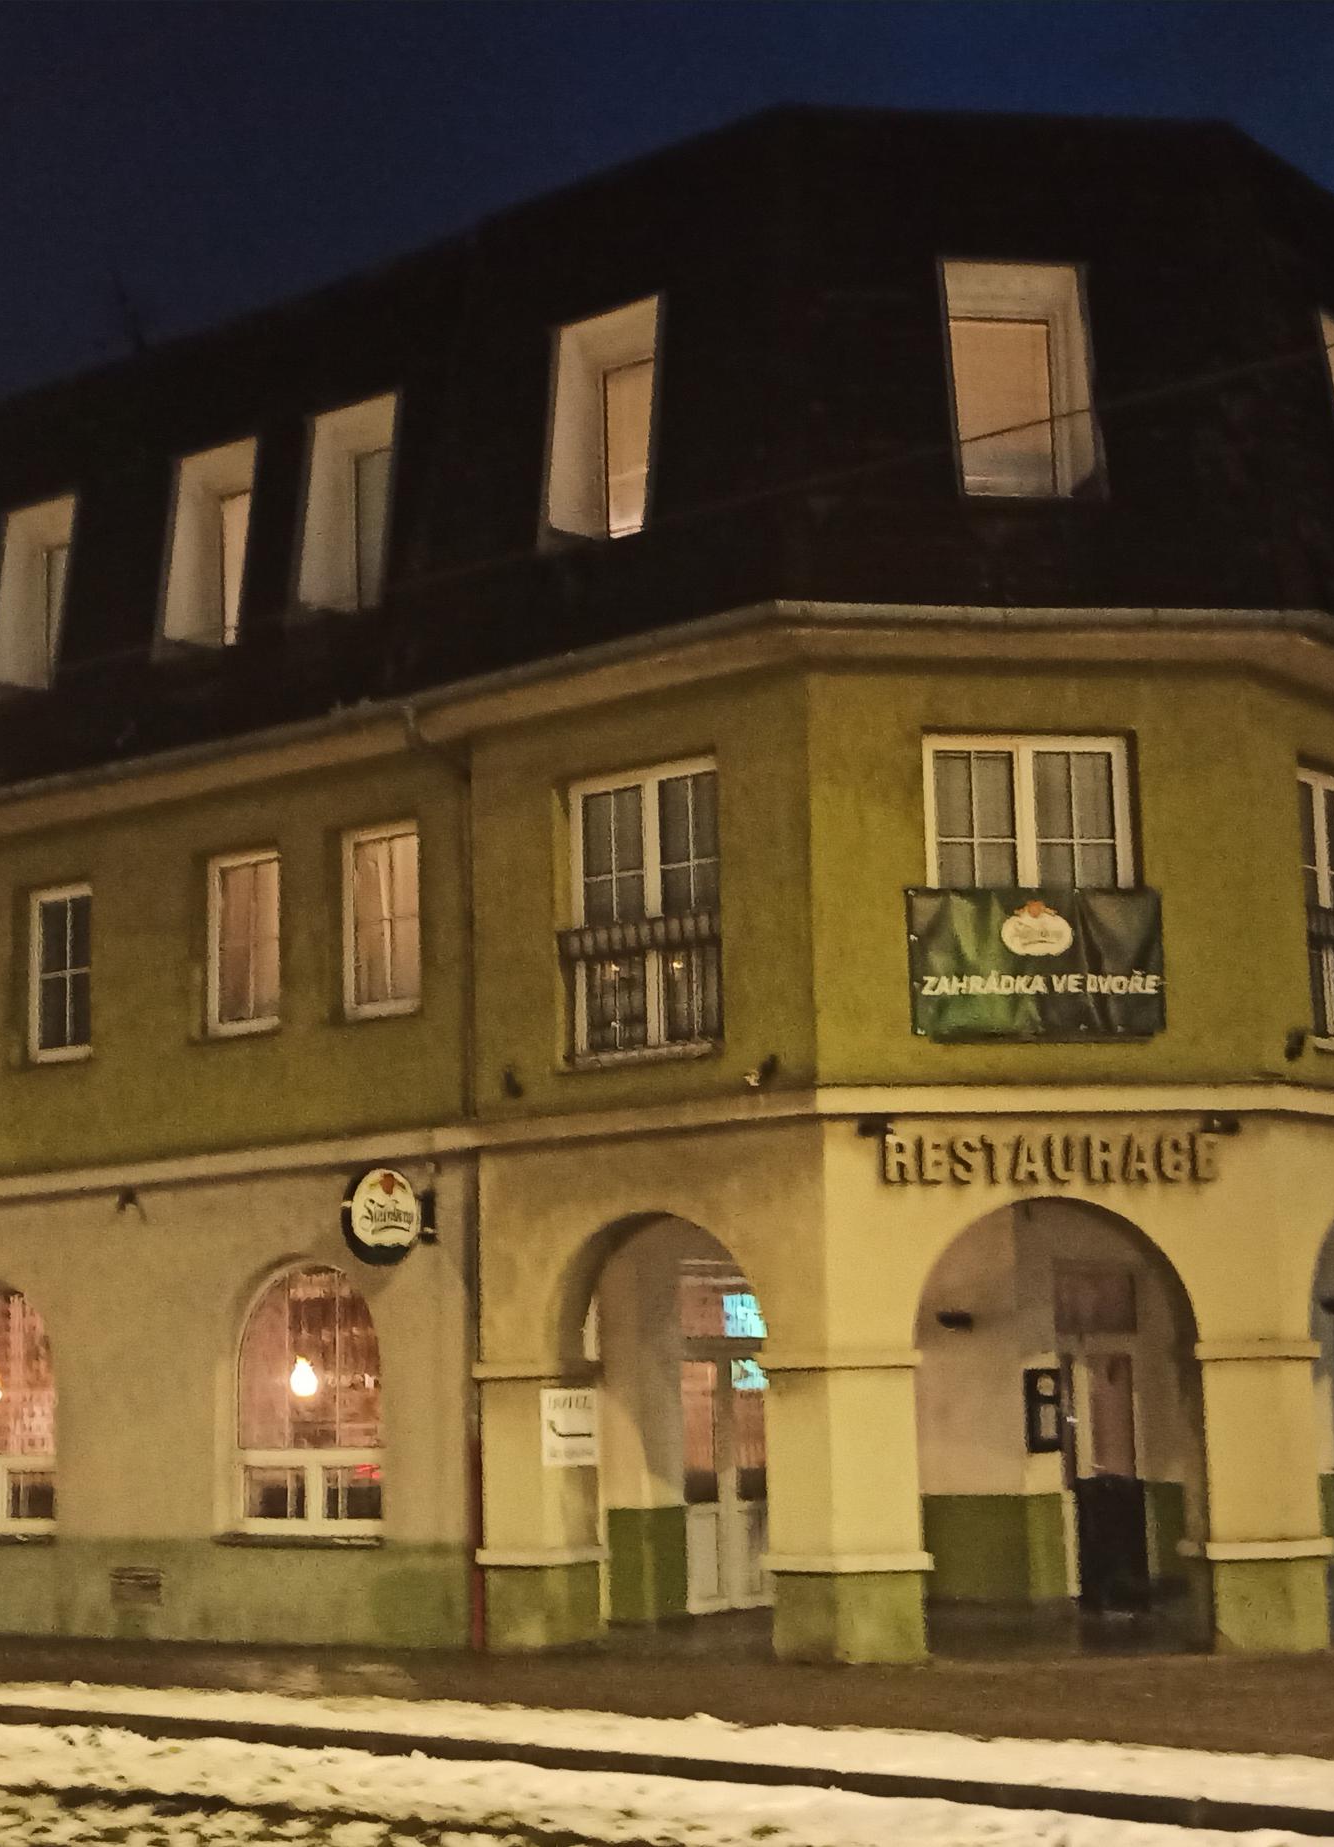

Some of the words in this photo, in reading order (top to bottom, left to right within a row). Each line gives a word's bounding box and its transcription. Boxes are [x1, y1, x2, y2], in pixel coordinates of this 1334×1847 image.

[921, 970, 1048, 996] ZAHRÁDKA
[1051, 974, 1085, 993] VE
[1086, 969, 1161, 994] DVOŘE
[880, 1133, 1220, 1185] RESTAURACE
